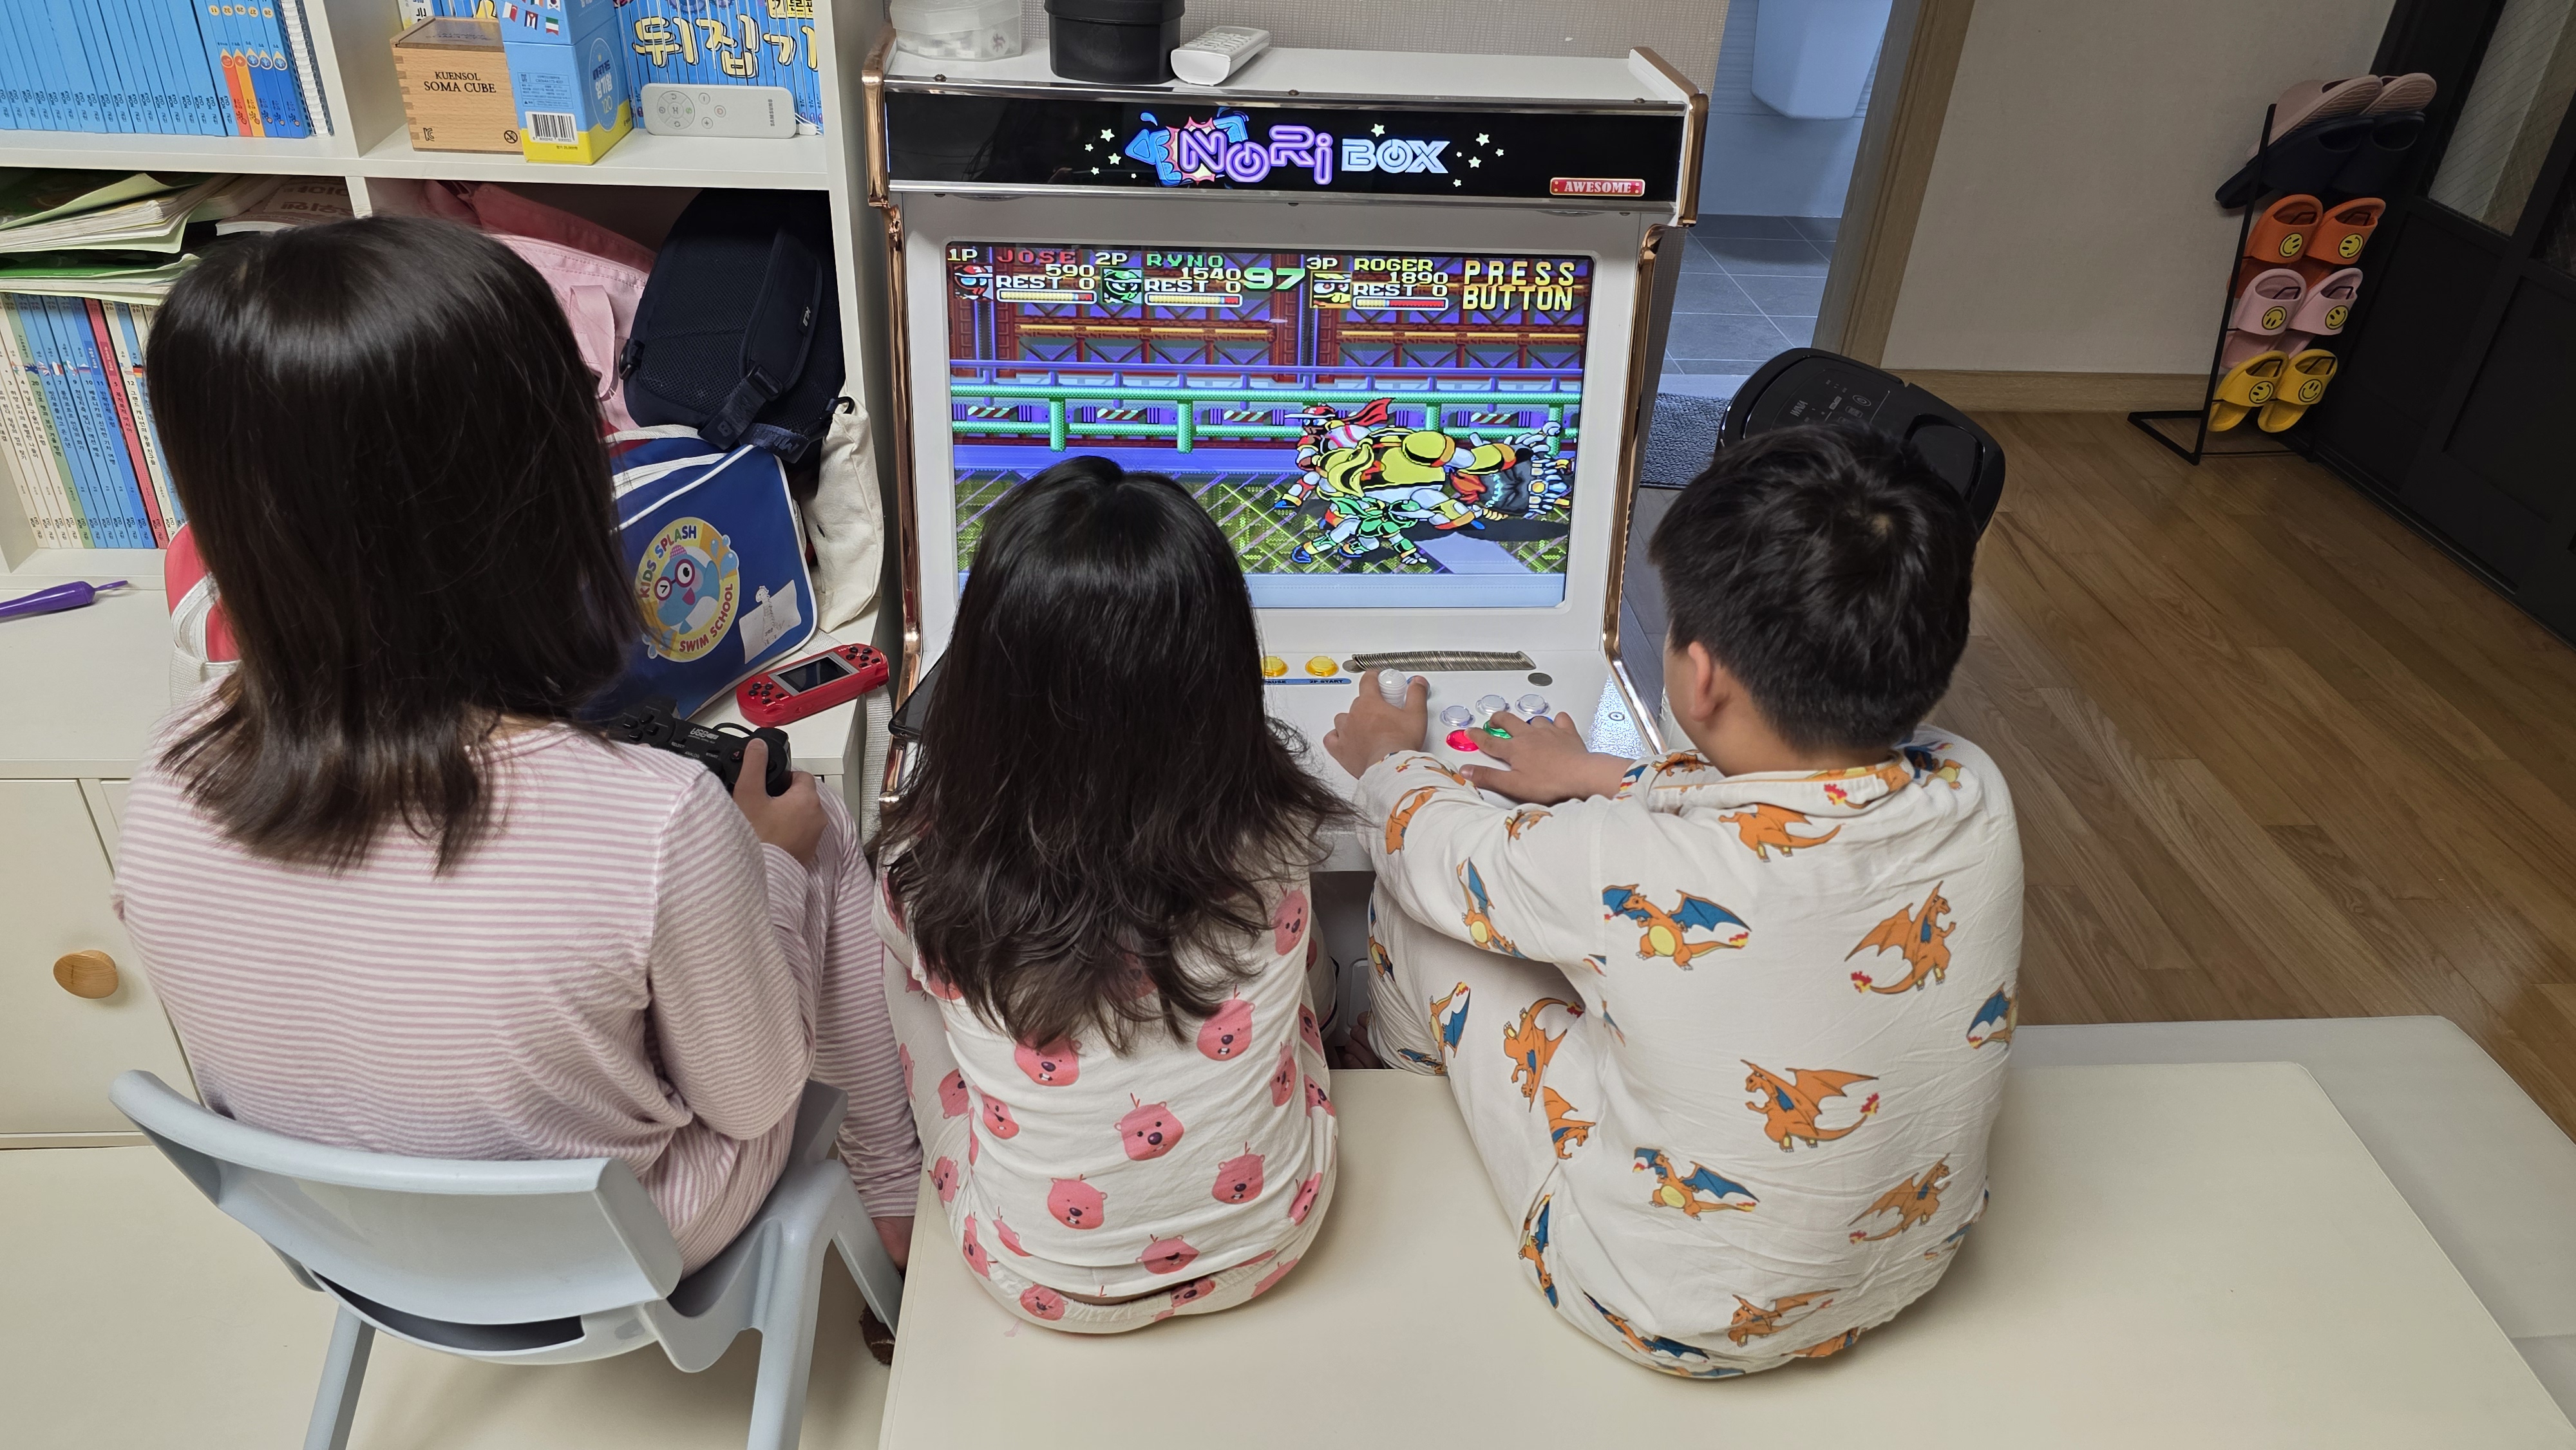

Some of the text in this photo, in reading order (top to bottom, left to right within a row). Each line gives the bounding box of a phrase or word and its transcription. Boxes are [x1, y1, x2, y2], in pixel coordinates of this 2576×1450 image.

[435, 71, 481, 81] KUENSOL
[424, 81, 497, 93] SOMA CUBE
[1341, 138, 1450, 174] BOX
[1564, 181, 1632, 193] AWESOME
[948, 249, 1076, 264] 1P JOSE
[1095, 252, 1127, 265] 2P
[1045, 264, 1095, 278] 590
[1307, 257, 1433, 272] 3P ROGER
[1181, 267, 1242, 281] 1540
[1244, 267, 1305, 290] 97
[1389, 272, 1448, 285] 1890
[1464, 261, 1575, 286] PRESS
[996, 276, 1095, 290] REST 0
[1144, 280, 1242, 294] REST 0
[1353, 284, 1448, 297] REST 0
[1463, 284, 1573, 310] BUTTON
[131, 391, 140, 407] 그랜드
[143, 435, 151, 447] 동물
[147, 449, 156, 466] 친구들
[104, 440, 111, 451] 기차
[640, 525, 697, 598] KIDS SPLASH
[679, 583, 733, 652] SWIM SCHOOL
[690, 728, 708, 738] USB
